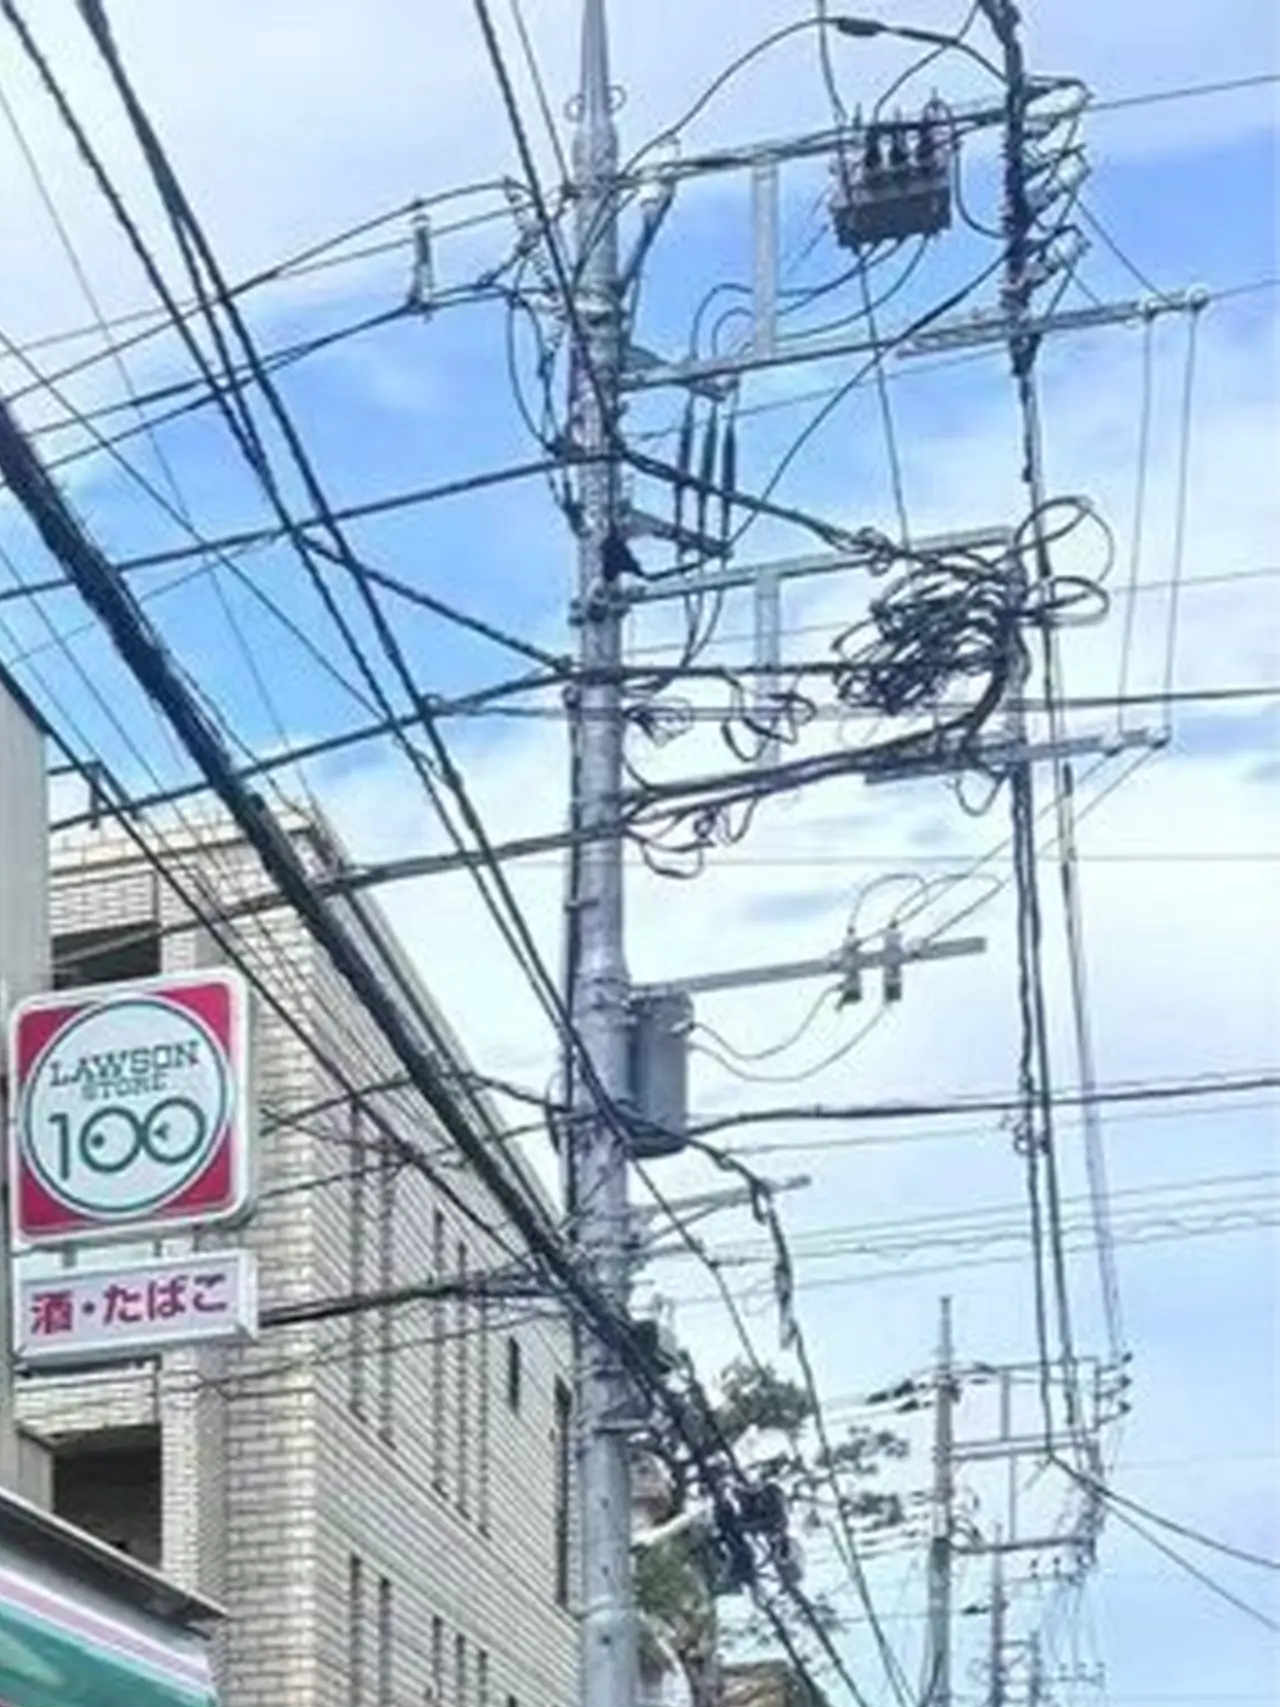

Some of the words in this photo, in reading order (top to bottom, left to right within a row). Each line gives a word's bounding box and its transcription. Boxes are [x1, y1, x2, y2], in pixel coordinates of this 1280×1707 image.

[50, 1041, 200, 1087] LAWSON
[82, 1073, 168, 1099] STORE
[48, 1097, 207, 1181] 100
[30, 1273, 228, 1335] 酒・たばこ
